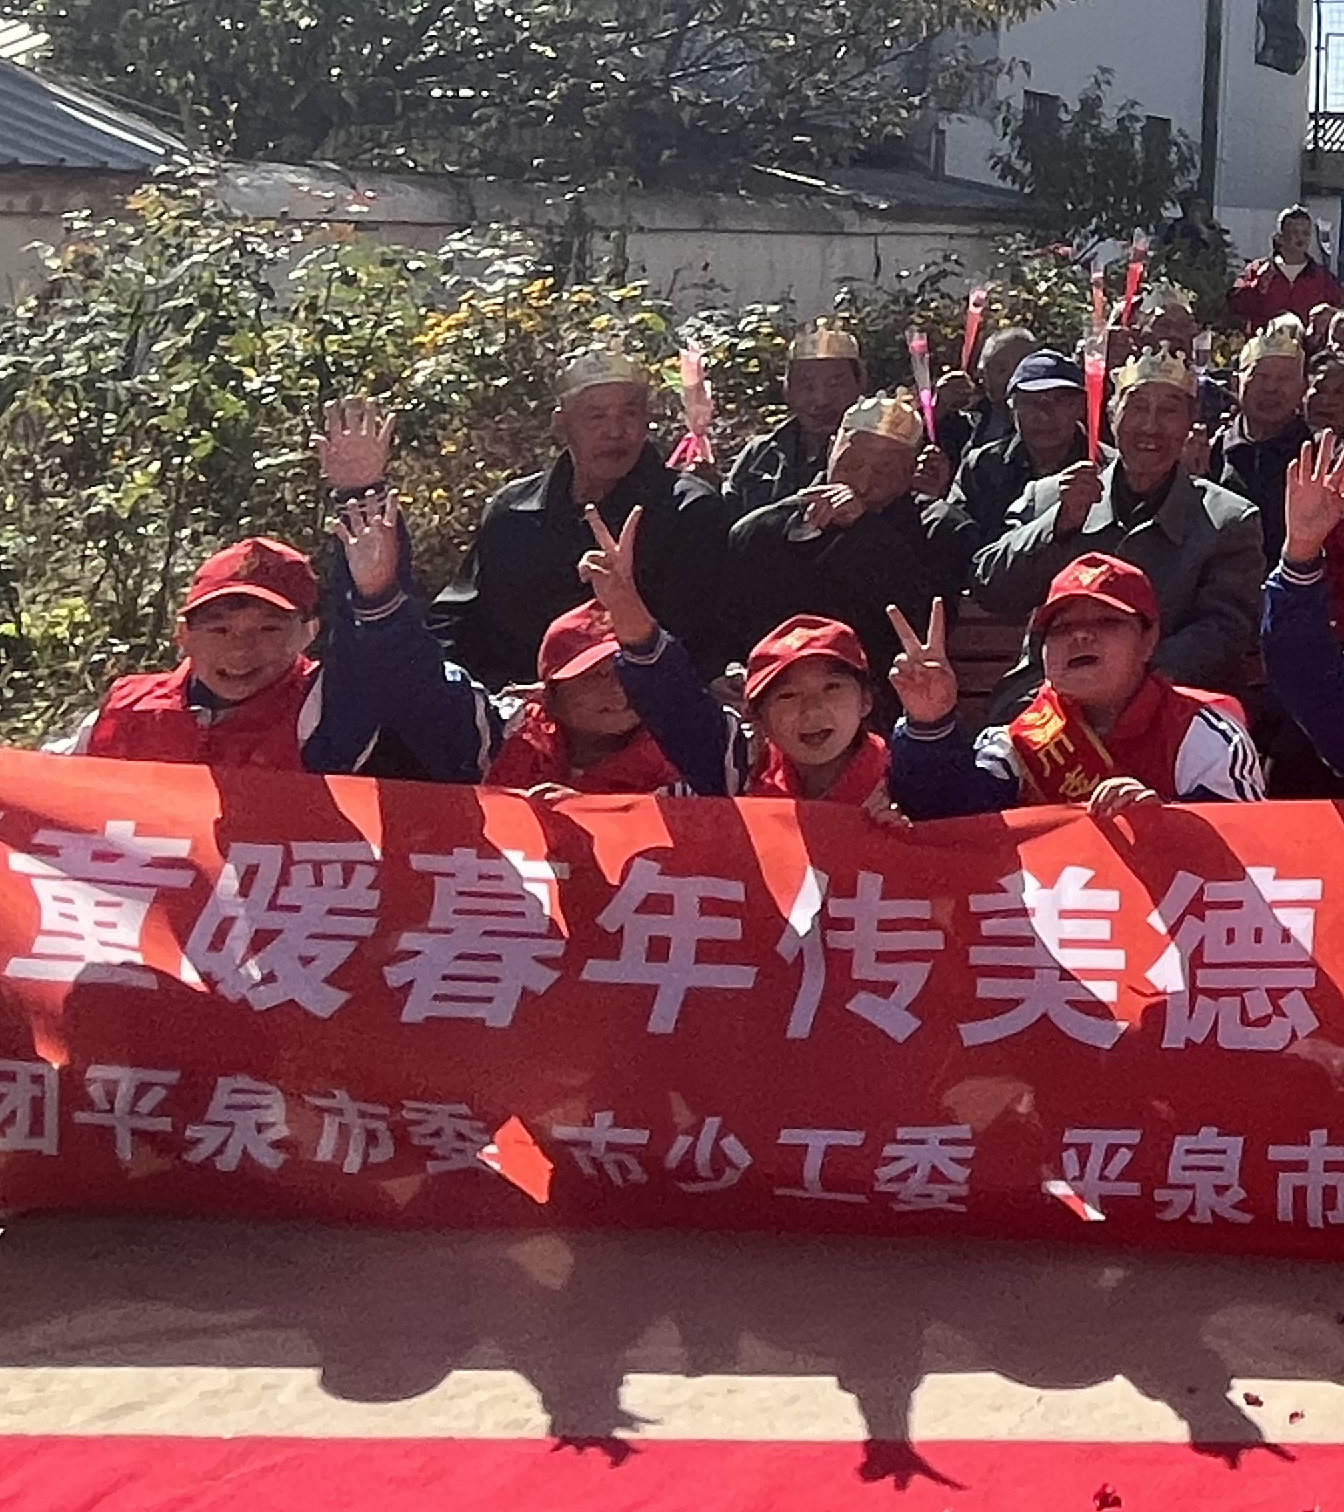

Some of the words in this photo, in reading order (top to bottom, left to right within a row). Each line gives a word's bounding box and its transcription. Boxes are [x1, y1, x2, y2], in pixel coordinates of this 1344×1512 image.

[4, 820, 1323, 1051] 童暖暮年传美德
[0, 1059, 503, 1176] 团平泉市委
